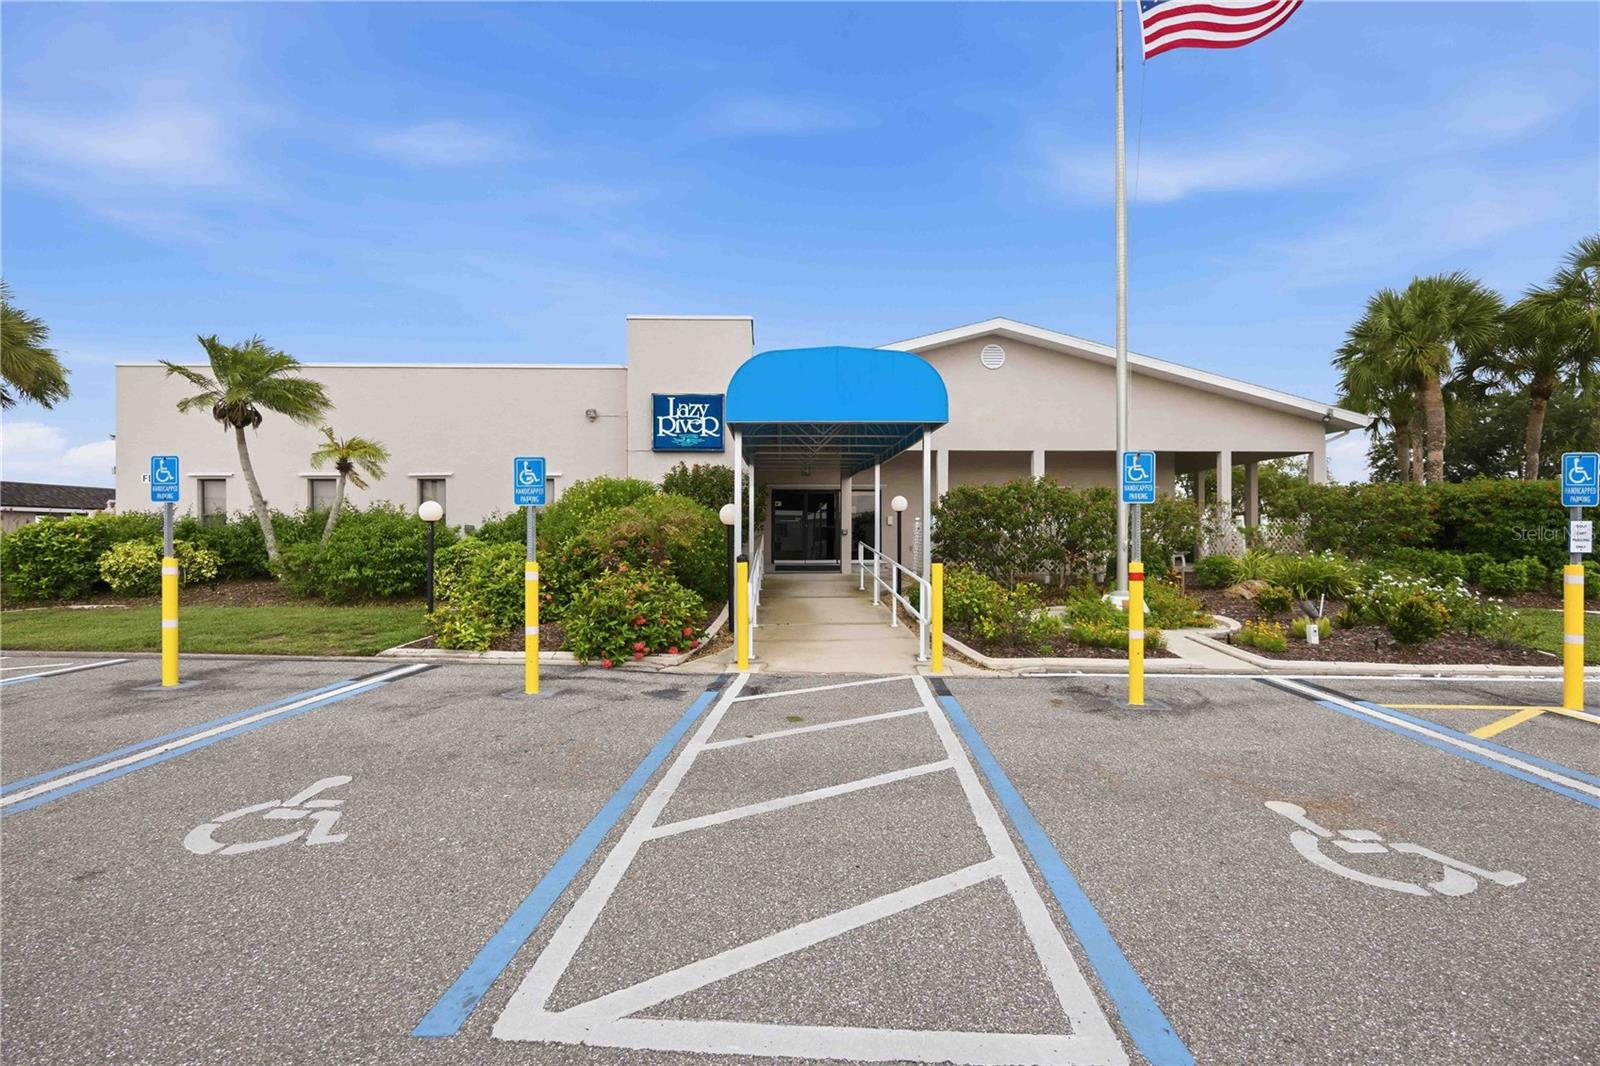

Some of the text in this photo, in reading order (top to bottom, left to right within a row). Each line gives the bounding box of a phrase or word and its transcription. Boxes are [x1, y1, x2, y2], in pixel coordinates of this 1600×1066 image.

[667, 397, 710, 419] Lazy
[515, 487, 545, 495] HANDICAPPED
[1564, 487, 1597, 495] HANDICAPPED
[1128, 492, 1149, 500] PARKING
